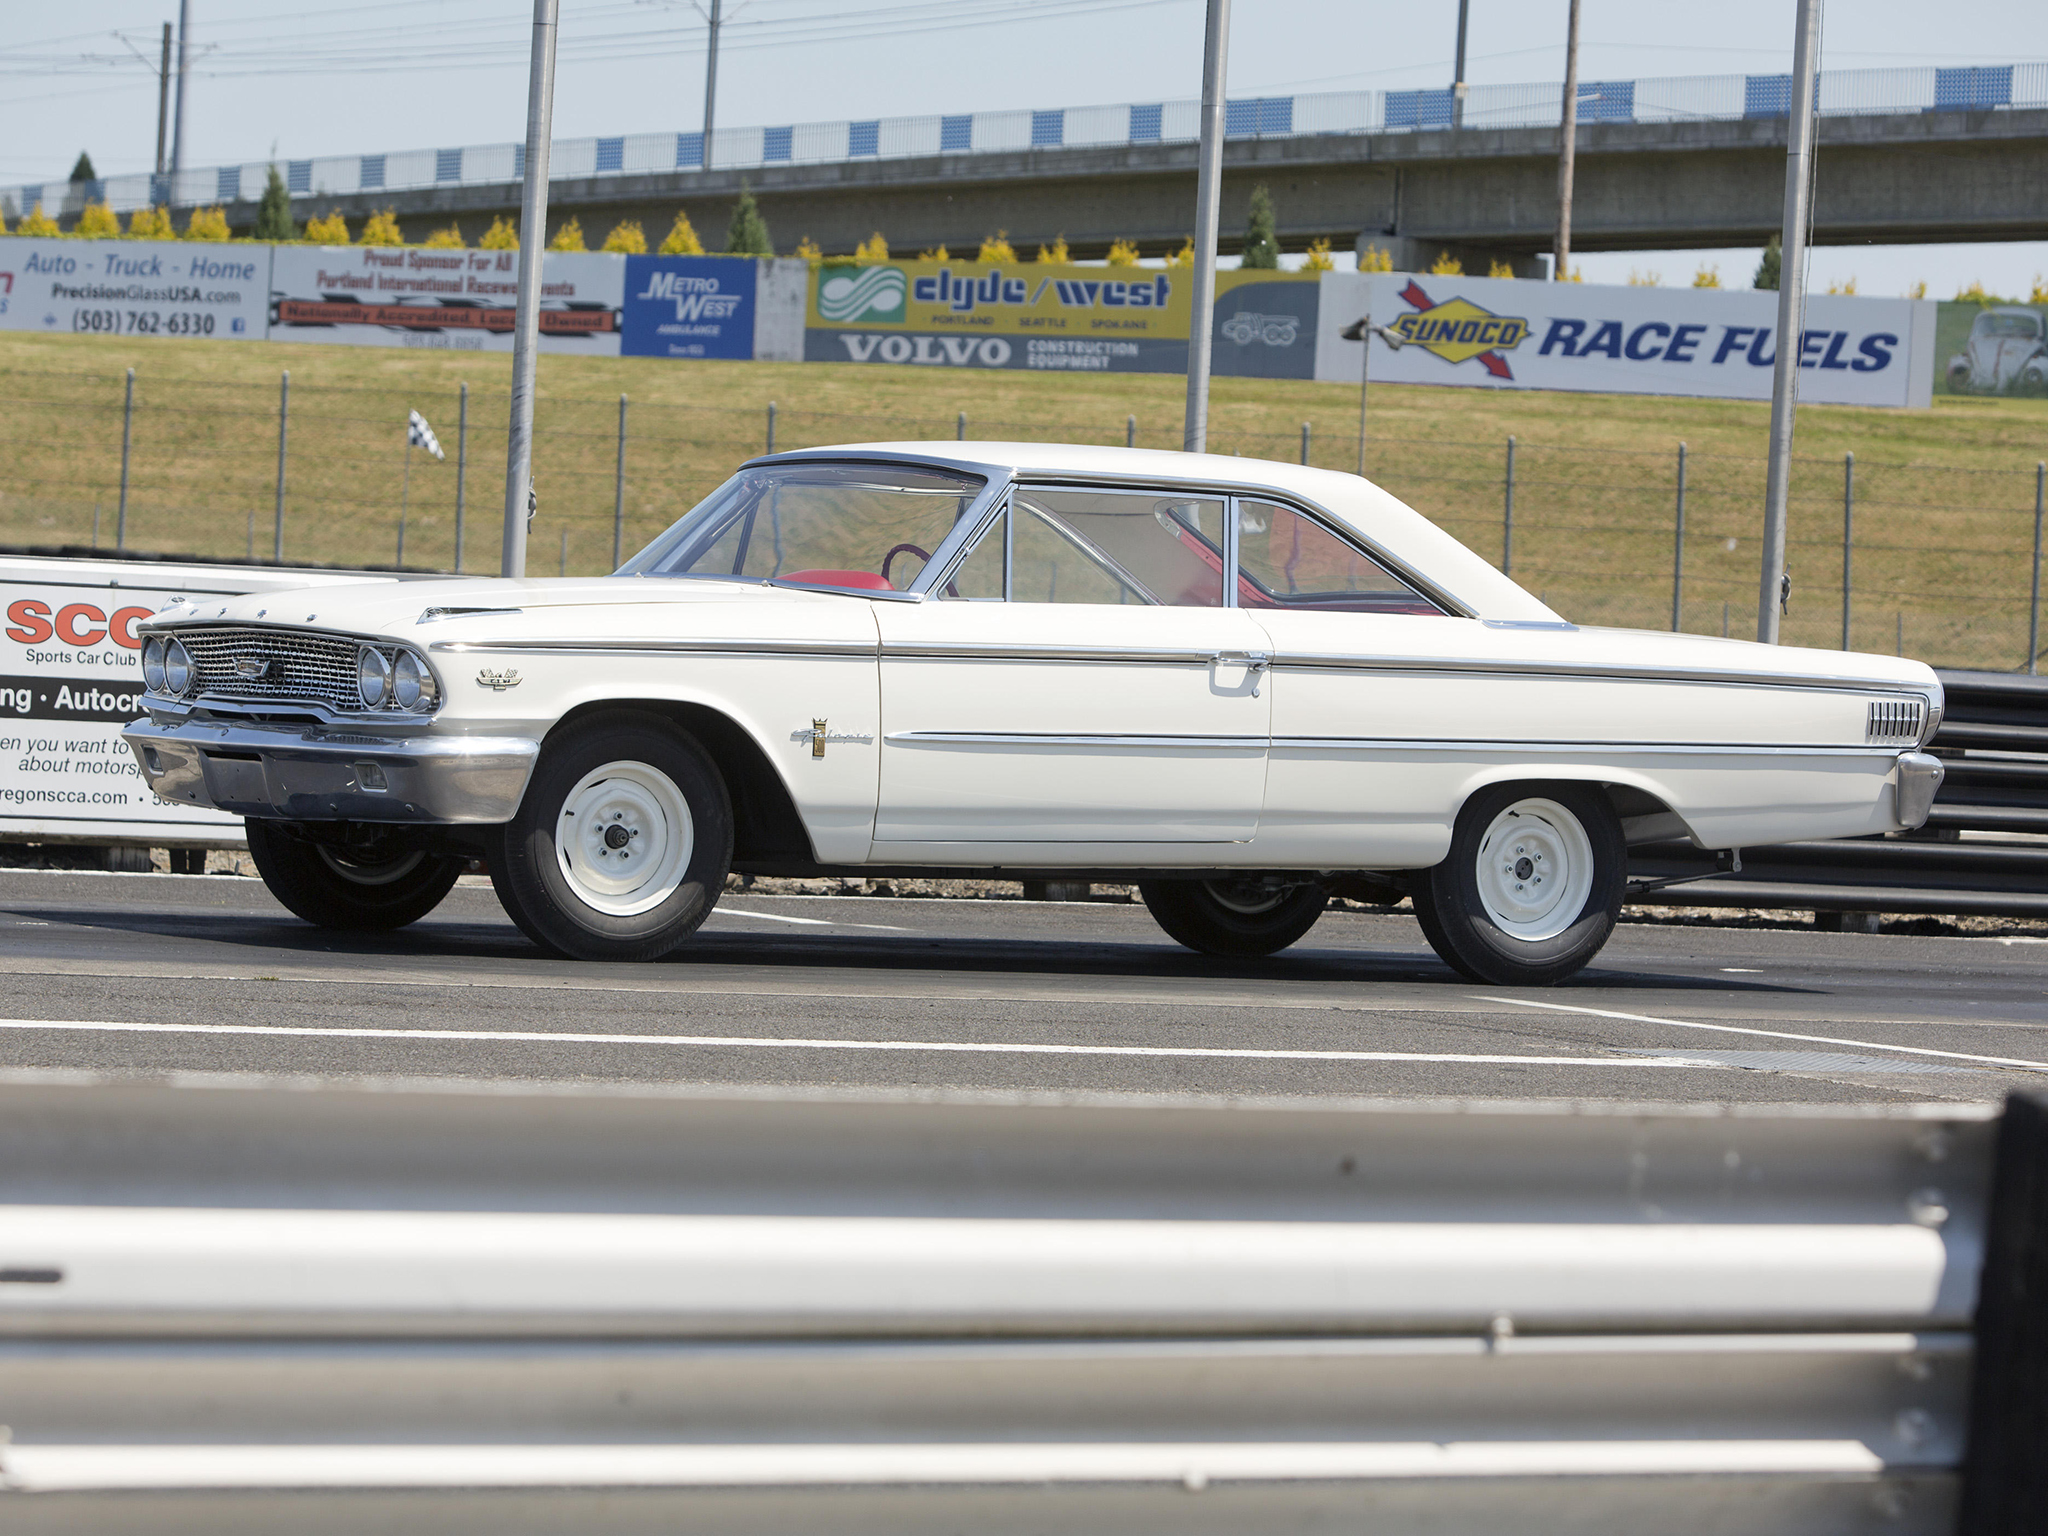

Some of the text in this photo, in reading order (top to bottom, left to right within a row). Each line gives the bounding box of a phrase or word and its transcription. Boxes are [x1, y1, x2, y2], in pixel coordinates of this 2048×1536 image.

[24, 252, 76, 274] Auto
[105, 253, 162, 276] Truck
[190, 256, 256, 280] Home
[364, 249, 512, 271] Proud Sponsor For All
[52, 283, 241, 304] PrecisionGlassUSA.com
[316, 269, 576, 296] Portland International Racewa vents
[646, 271, 720, 299] METRO
[287, 303, 369, 321] Nationally
[676, 294, 739, 322] WEST
[73, 308, 215, 335] (503) 762-6330
[931, 314, 1148, 330] PORTLAND SEATTLE SPOKANE
[1399, 317, 1522, 345] SUNOCO
[839, 333, 1012, 366] VOLVO
[1026, 339, 1139, 358] CONSTRUCTION
[1538, 317, 1899, 372] RACE FUELS
[1027, 353, 1110, 369] EQUIPMENT
[26, 648, 137, 666] Sports Car Club
[54, 685, 149, 713] Autocr
[25, 739, 59, 755] you
[64, 739, 107, 754] want
[112, 739, 129, 754] to
[19, 756, 69, 773] about
